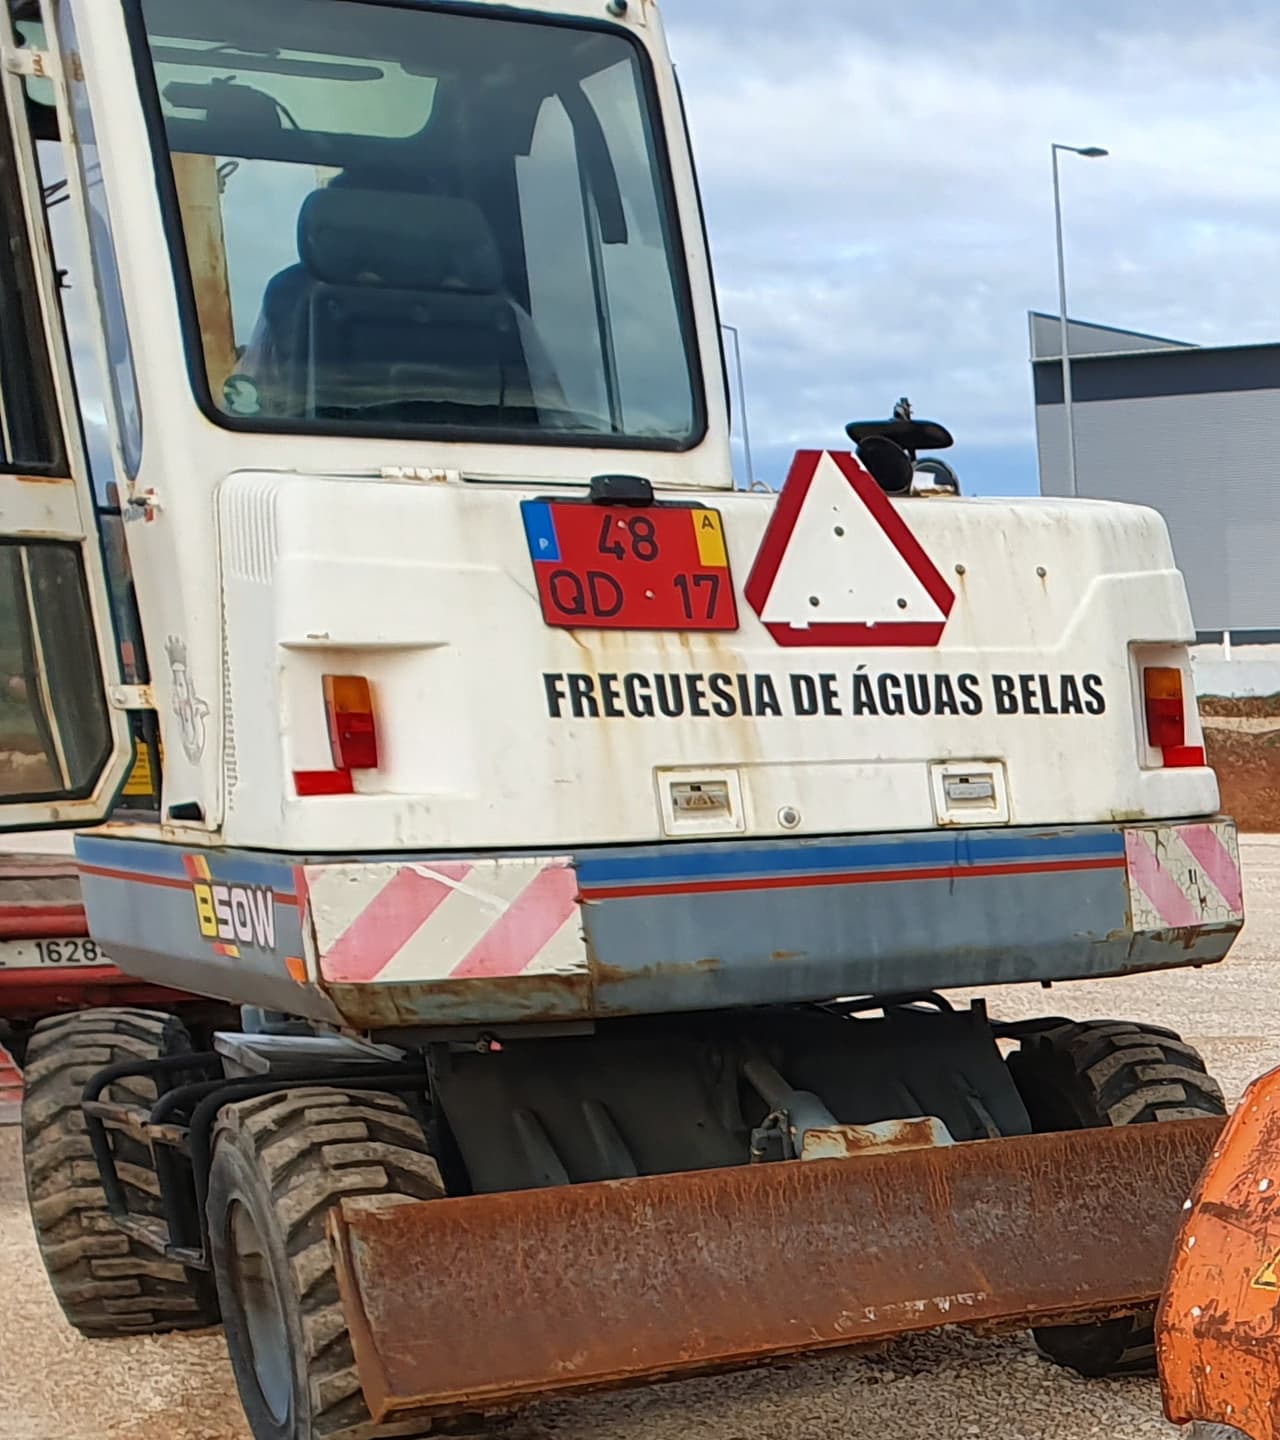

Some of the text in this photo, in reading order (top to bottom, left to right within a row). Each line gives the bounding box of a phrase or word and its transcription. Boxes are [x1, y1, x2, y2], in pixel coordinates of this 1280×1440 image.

[598, 514, 659, 562] 48
[701, 515, 715, 530] A
[538, 538, 549, 550] P
[549, 569, 720, 620] QD 17
[542, 664, 1106, 718] FREGUESIA DE ÁGUAS BELAS
[35, 940, 112, 963] 1628
